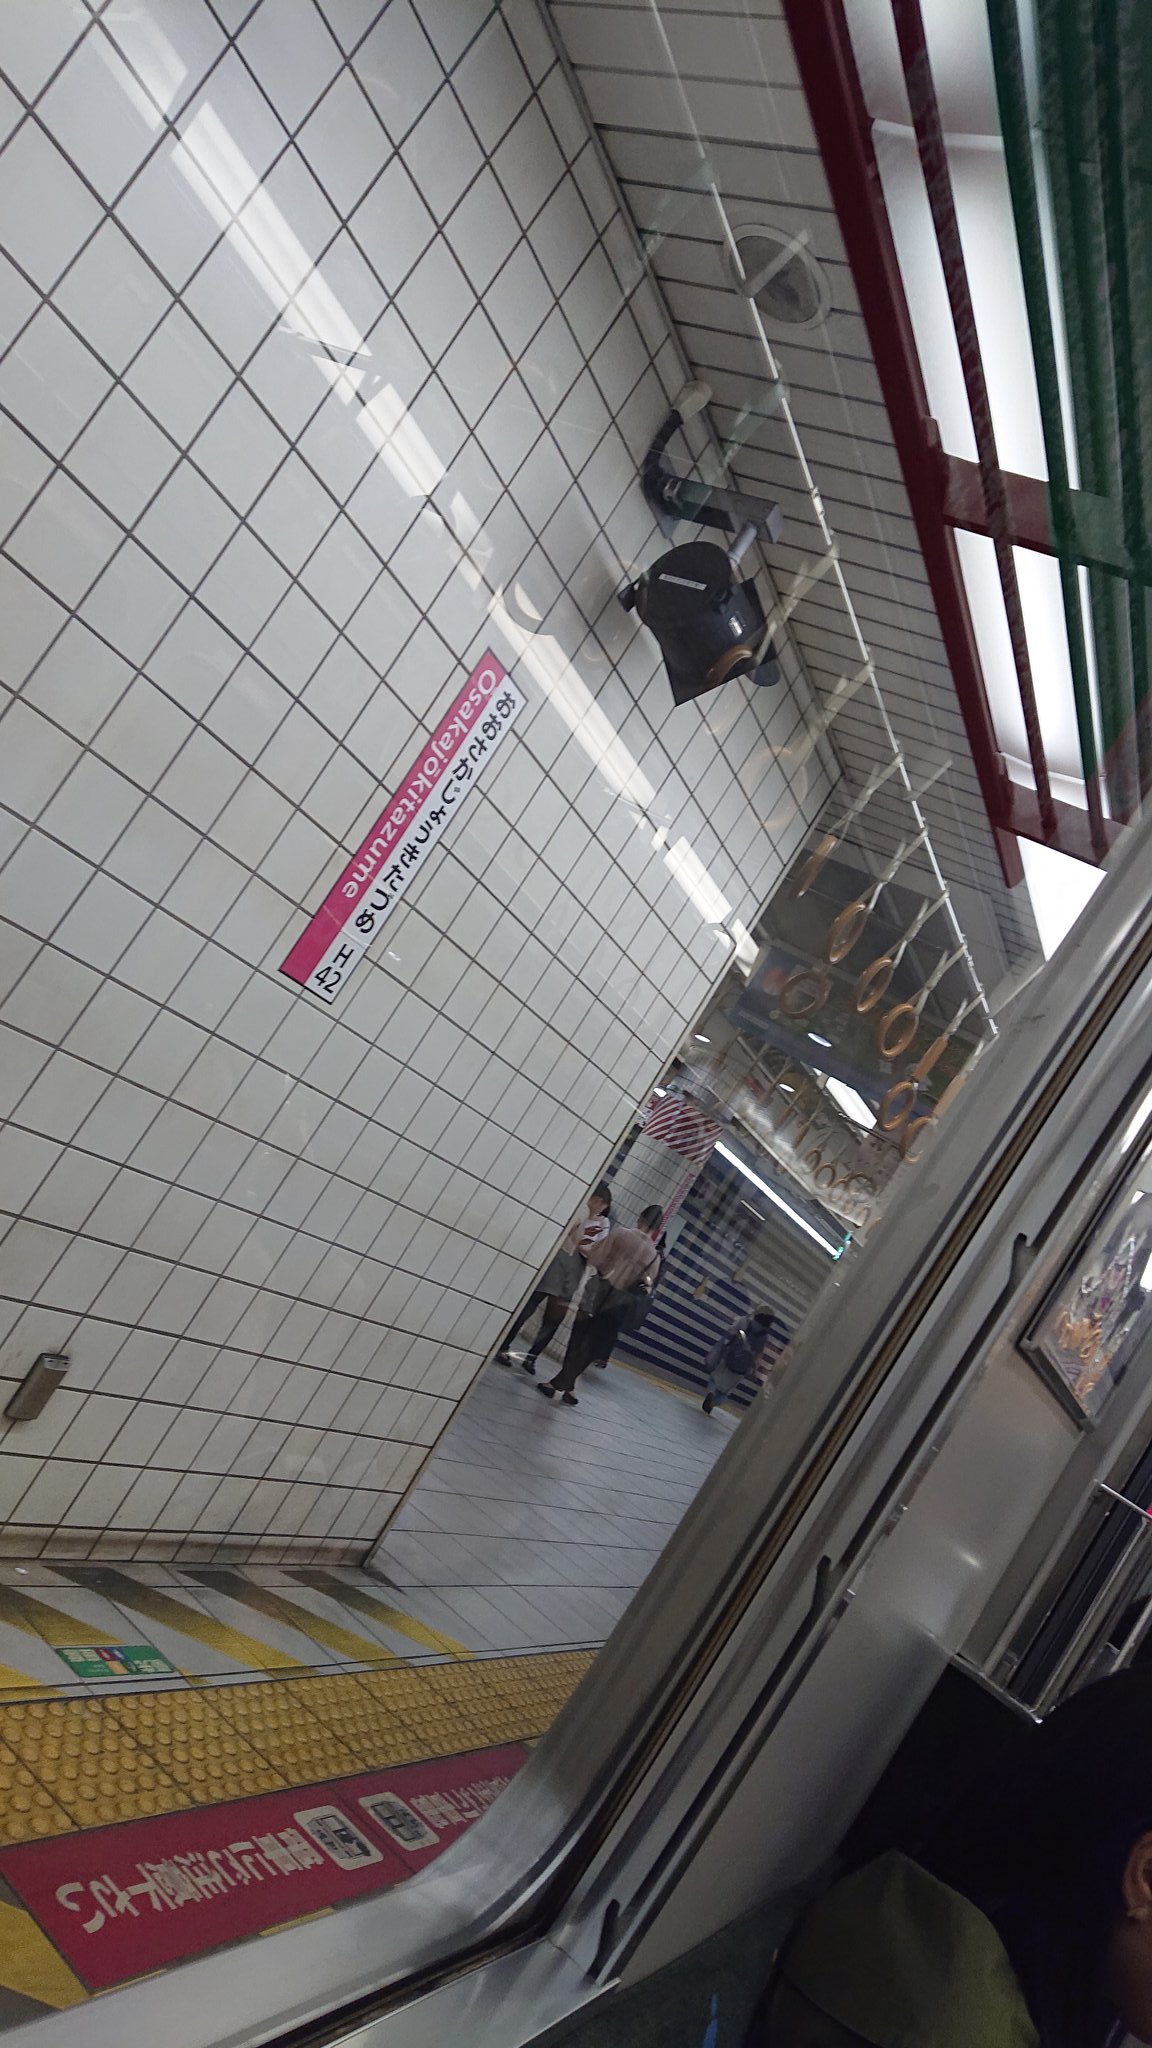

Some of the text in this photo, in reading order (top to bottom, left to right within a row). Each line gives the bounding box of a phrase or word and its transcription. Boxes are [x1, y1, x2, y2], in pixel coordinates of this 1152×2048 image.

[344, 668, 497, 899] Osakajōkitazume
[354, 691, 516, 934] おおさかじょうきたづめ
[314, 966, 343, 994] 42
[332, 943, 355, 968] H
[55, 1827, 325, 1934] 電車にご注意下さい
